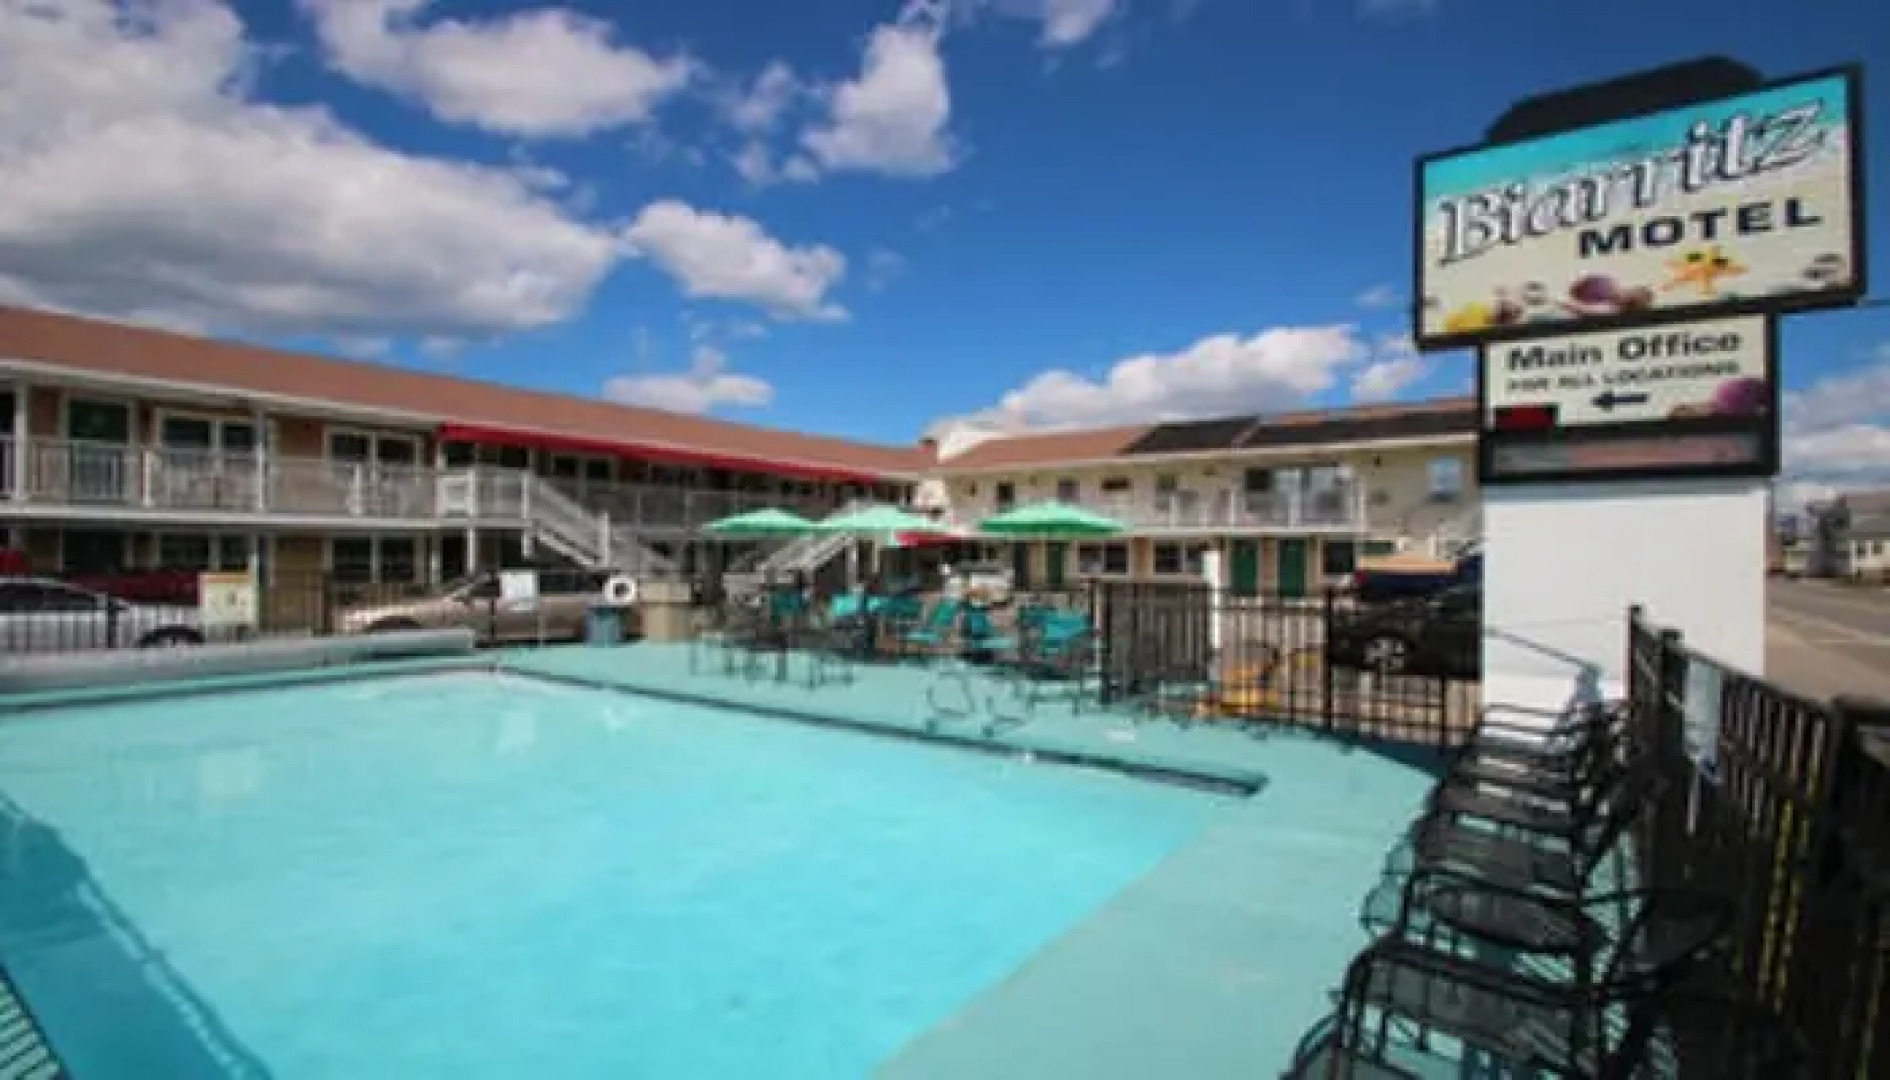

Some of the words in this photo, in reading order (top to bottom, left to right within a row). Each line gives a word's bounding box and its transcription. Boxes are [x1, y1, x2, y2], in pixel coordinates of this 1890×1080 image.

[1437, 98, 1826, 267] Biarritz
[1578, 197, 1824, 258] MOTEL
[1509, 345, 1602, 369] Main
[1618, 333, 1740, 360] Office
